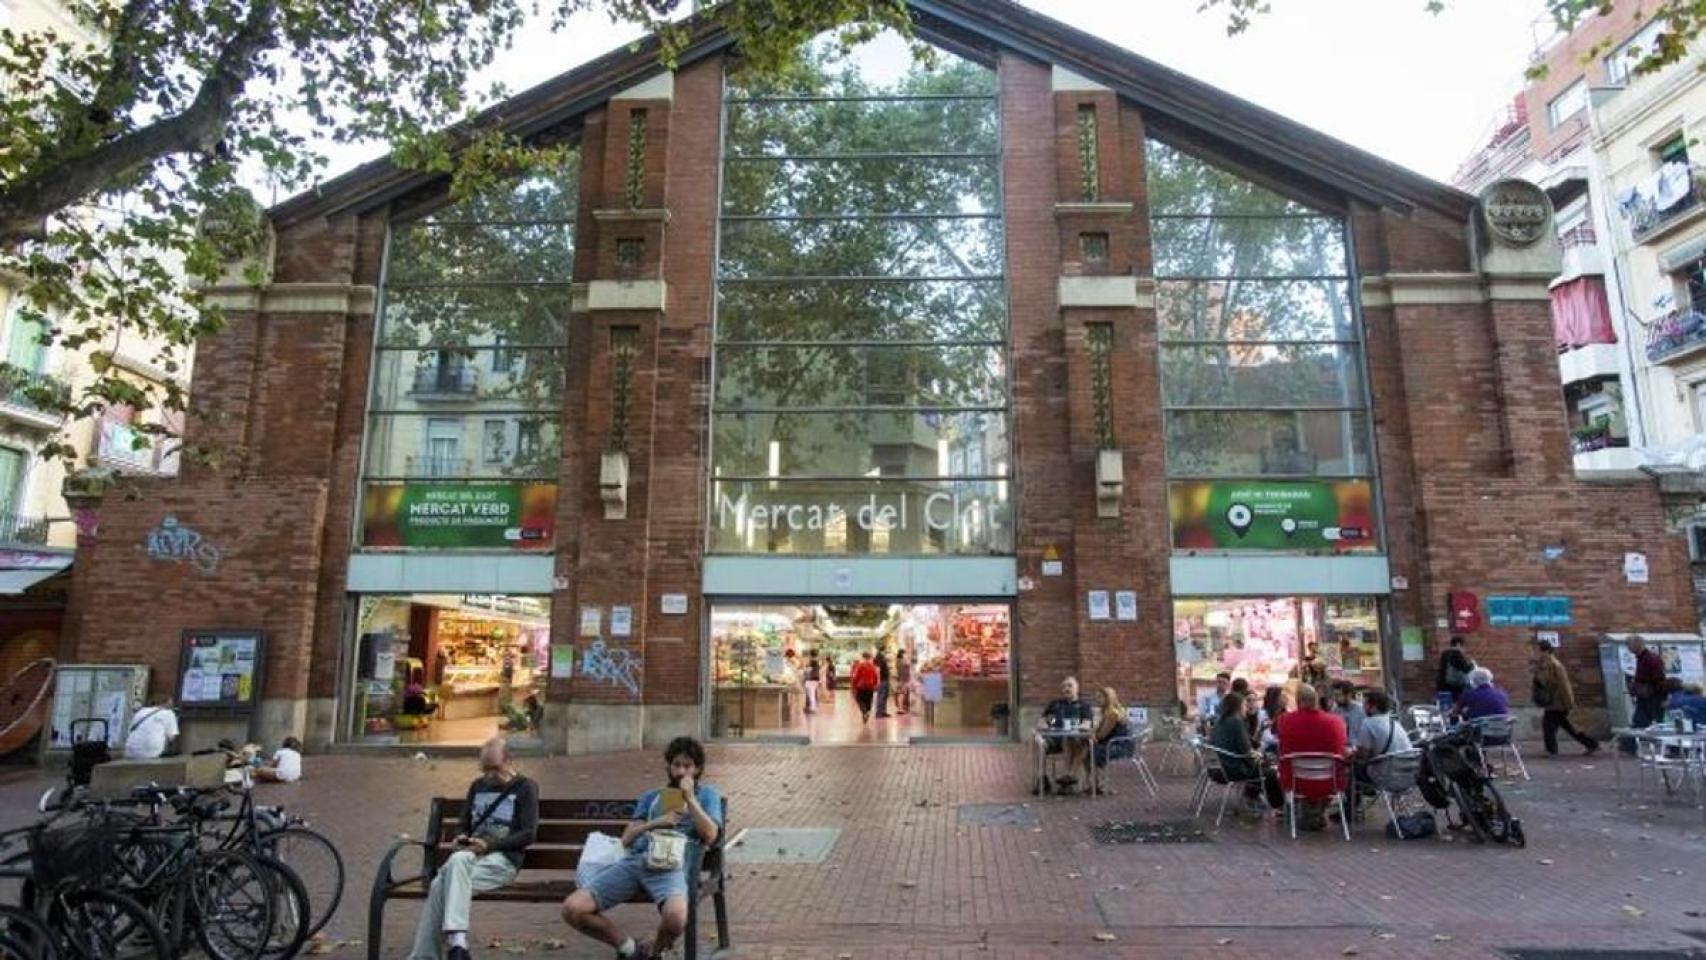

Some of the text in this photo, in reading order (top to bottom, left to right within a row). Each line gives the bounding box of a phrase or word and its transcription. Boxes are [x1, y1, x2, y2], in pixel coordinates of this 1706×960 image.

[410, 502, 511, 515] MERCAT VERD
[719, 491, 1002, 531] Mercat del Clot
